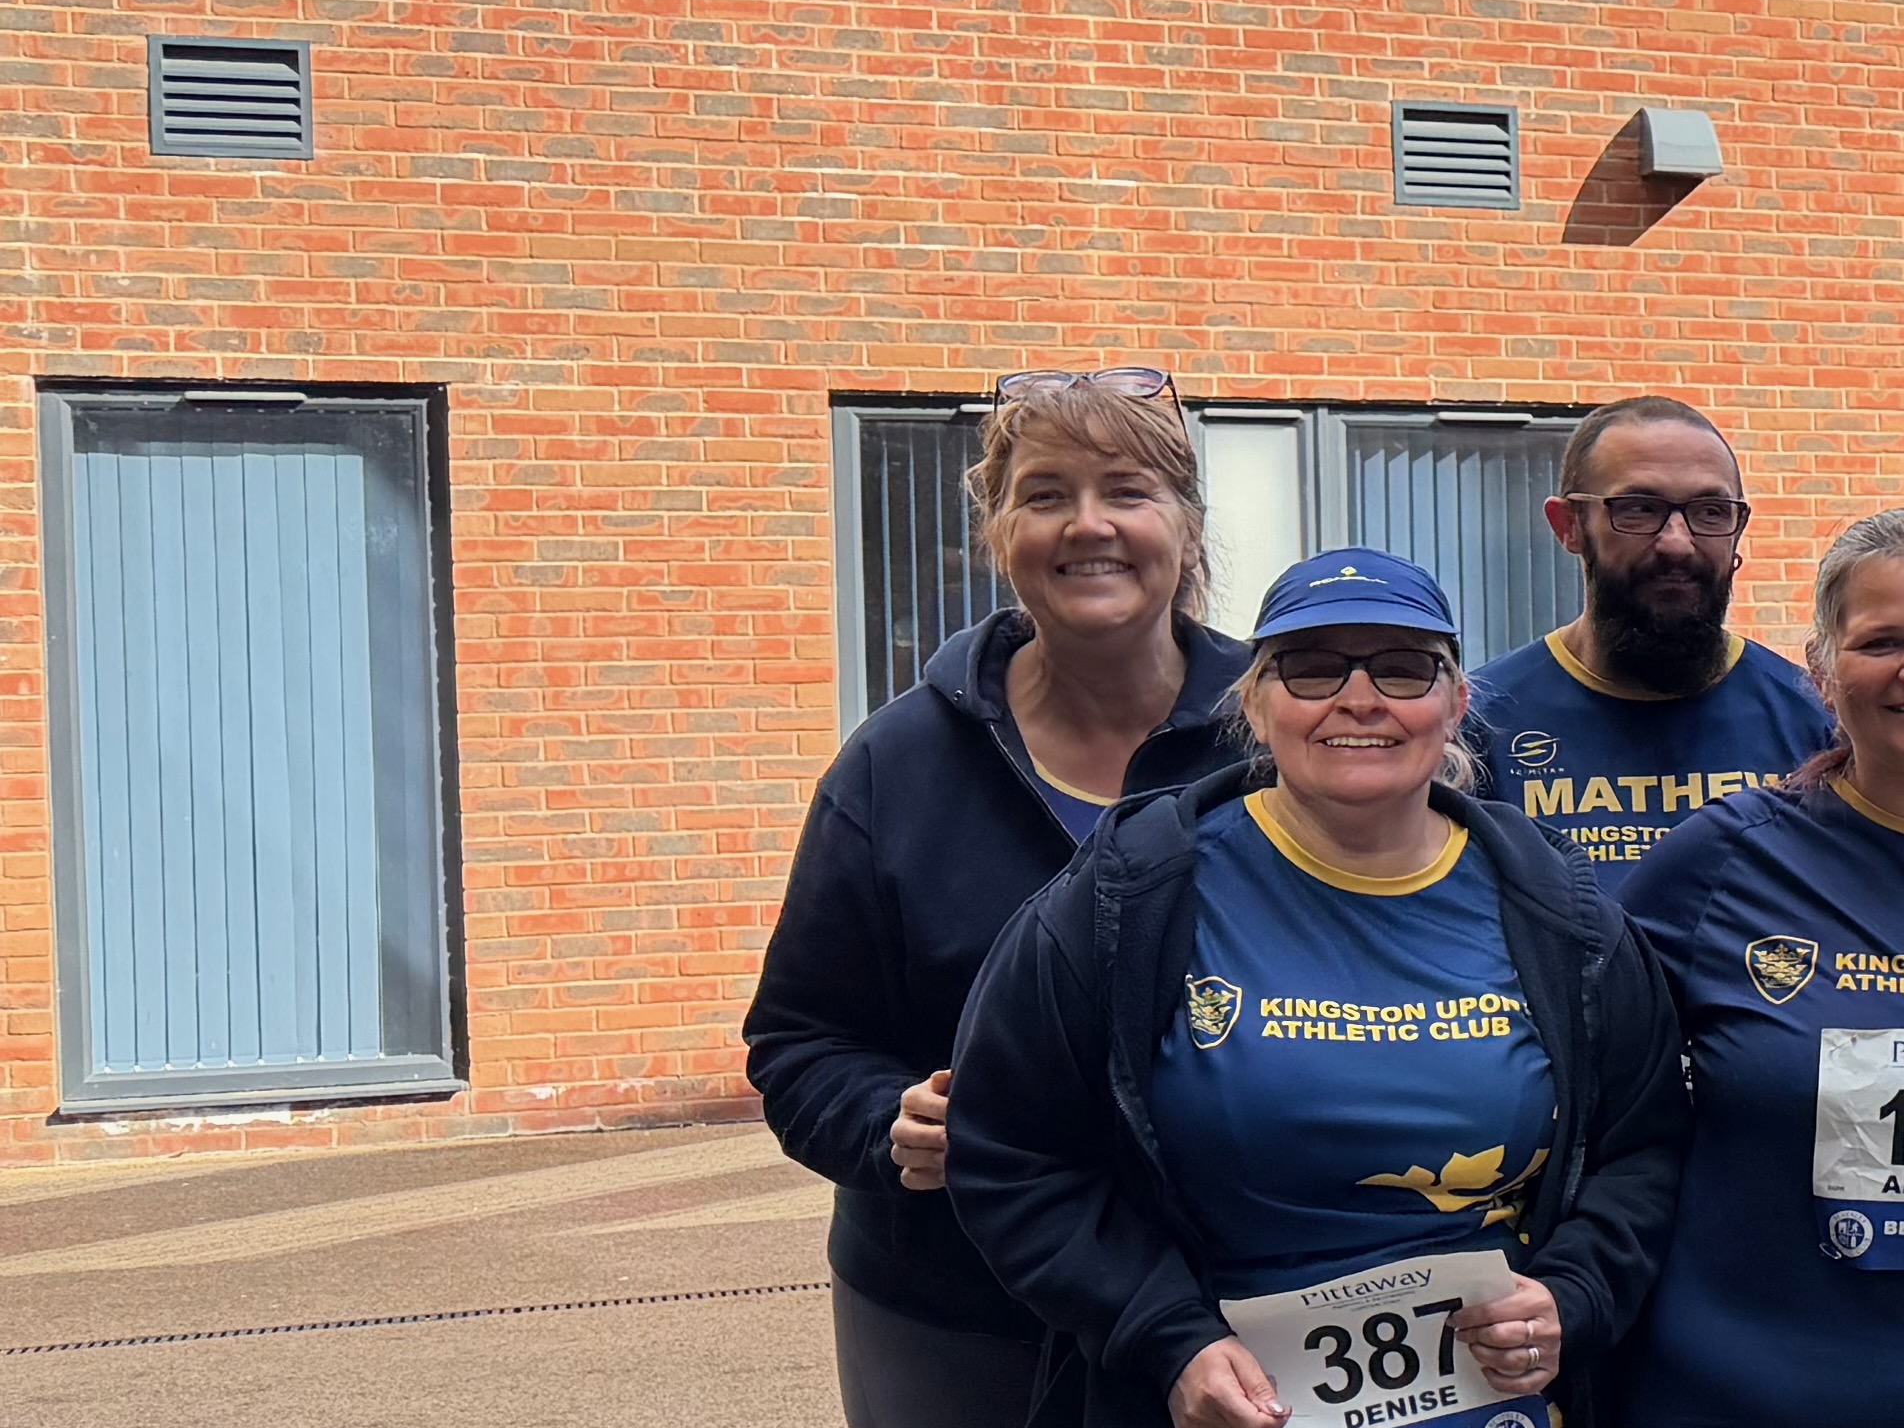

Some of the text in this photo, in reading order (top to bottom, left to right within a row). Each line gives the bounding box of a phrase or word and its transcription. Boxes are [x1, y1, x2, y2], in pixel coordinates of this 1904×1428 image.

[1260, 998, 1426, 1022] KINGSTON
[1261, 1016, 1511, 1042] ATHLETIC CLUB
[1300, 1268, 1432, 1306] Pittaway
[1302, 1297, 1464, 1404] 387
